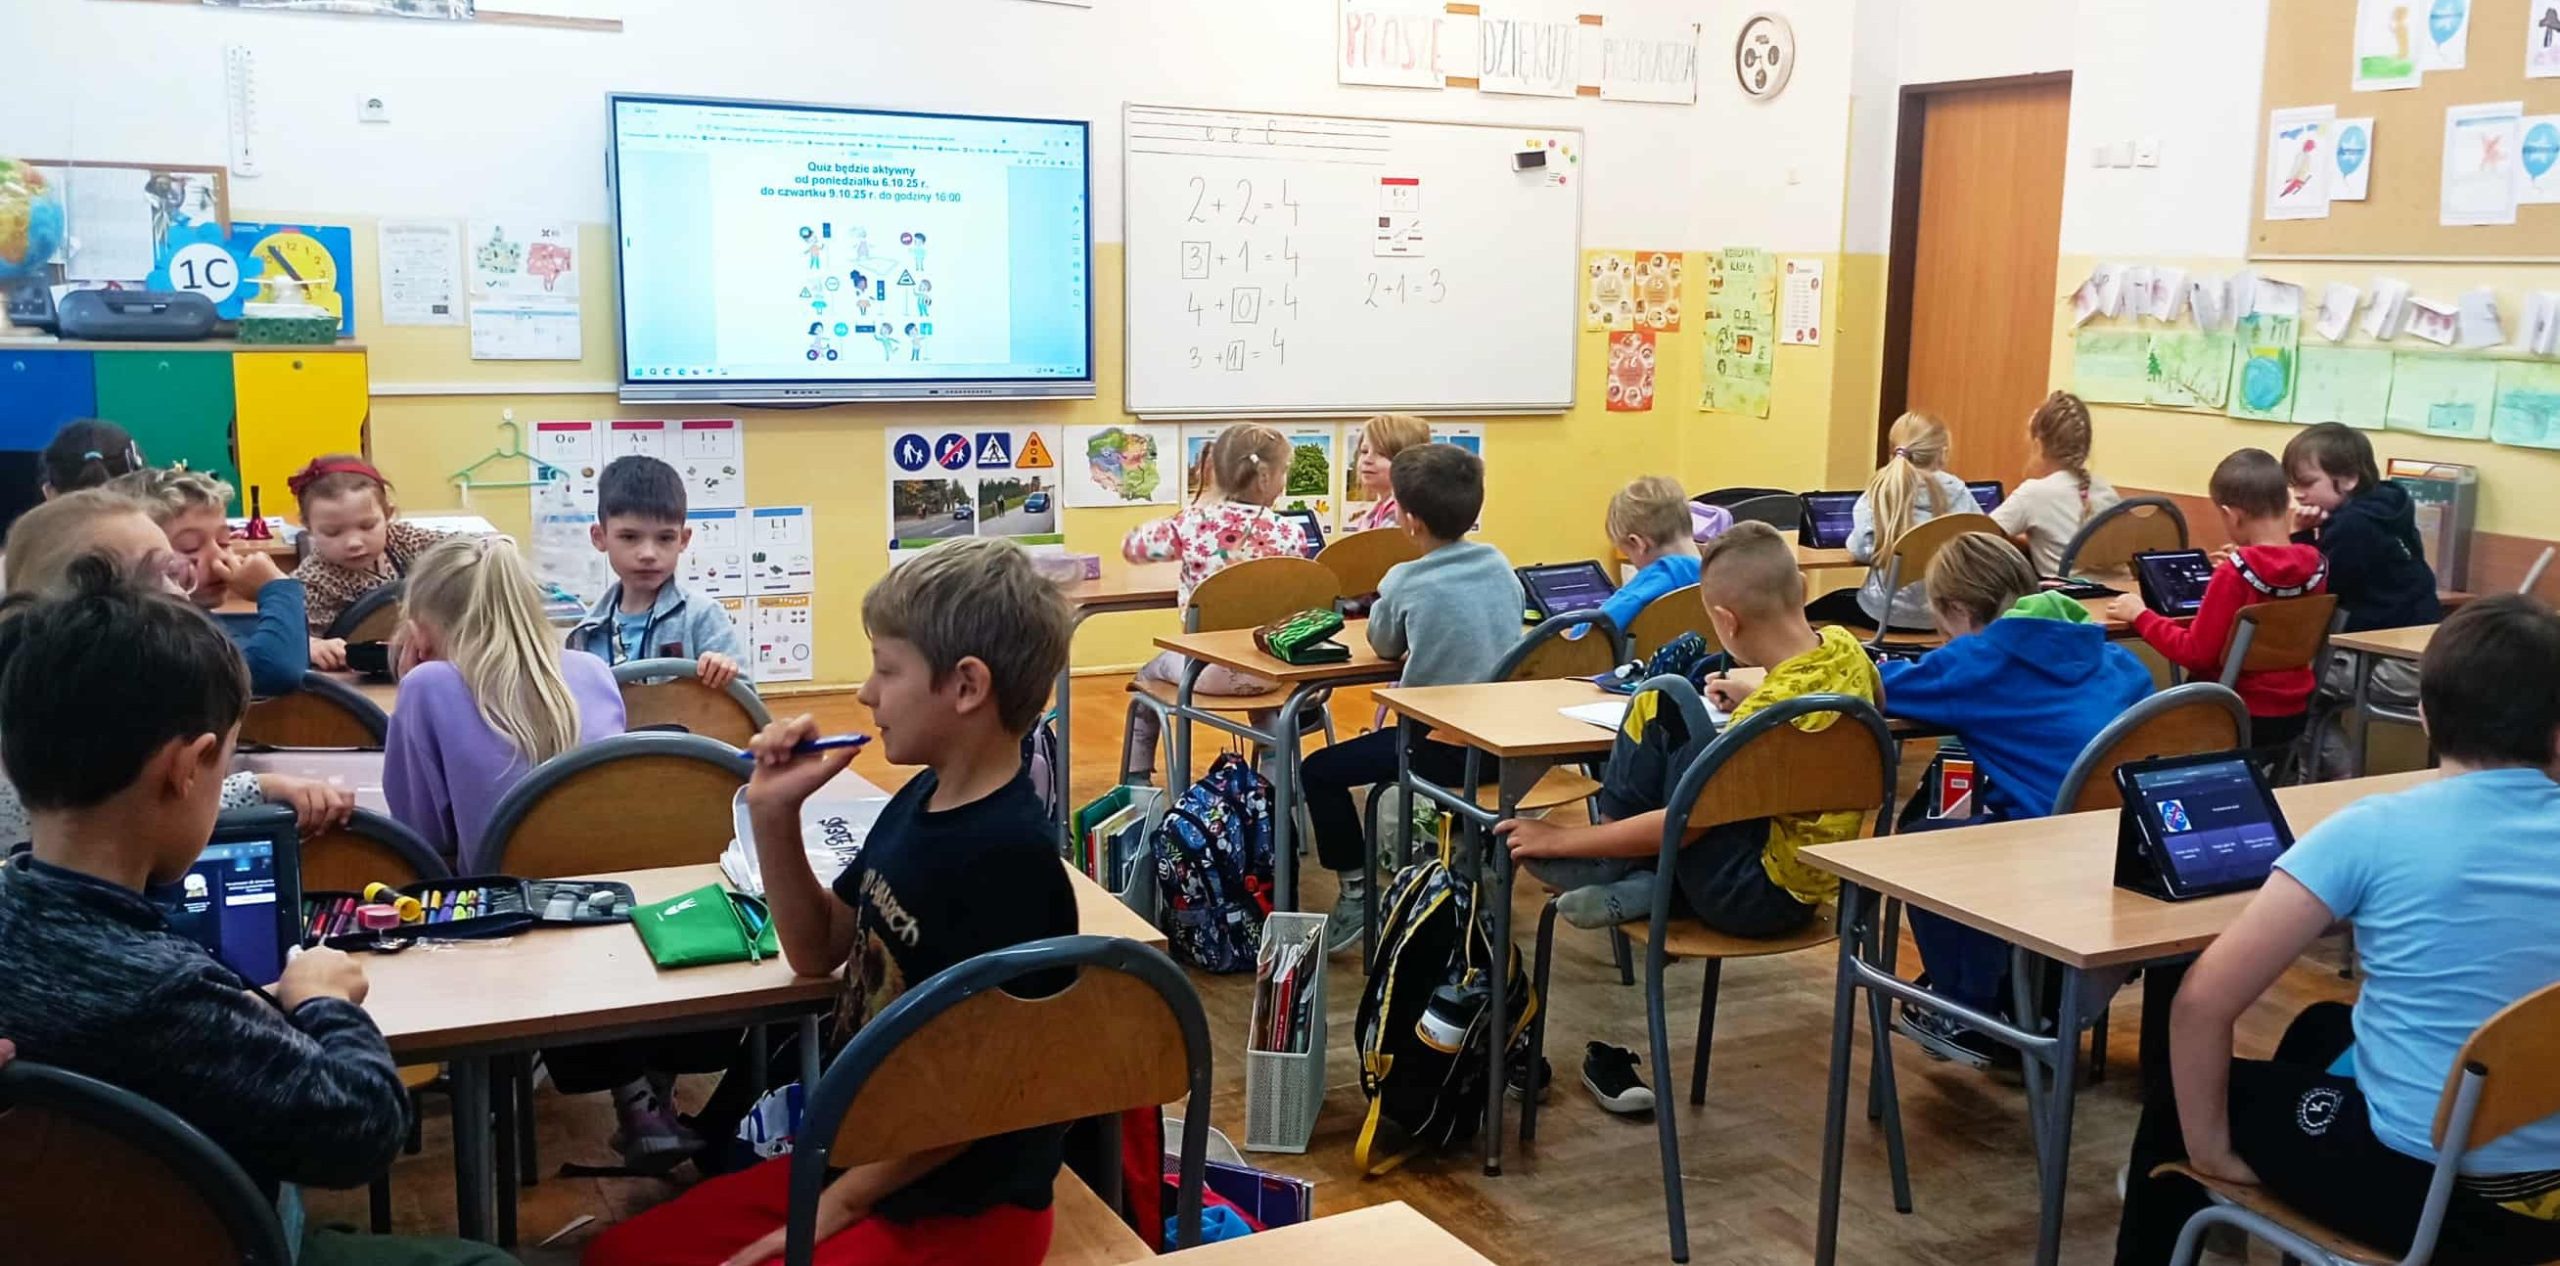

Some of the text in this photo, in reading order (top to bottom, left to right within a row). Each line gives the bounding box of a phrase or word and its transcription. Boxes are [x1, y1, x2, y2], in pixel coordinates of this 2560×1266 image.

[794, 175, 809, 184] od
[807, 161, 832, 173] Quiz
[872, 165, 915, 177] aktywny
[760, 186, 775, 196] do
[777, 187, 826, 198] czwartku
[879, 190, 892, 200] do
[894, 191, 932, 203] godziny
[1187, 176, 1206, 223] 2
[1236, 178, 1258, 225] 2
[1283, 178, 1301, 226] 4
[1238, 240, 1249, 273] 1
[1283, 233, 1301, 278] 4
[179, 258, 231, 290] 1C
[1429, 268, 1446, 303] 3
[1188, 291, 1204, 328] 4
[1284, 282, 1300, 321] 4
[1189, 346, 1203, 370] 3
[1272, 327, 1285, 366] 4
